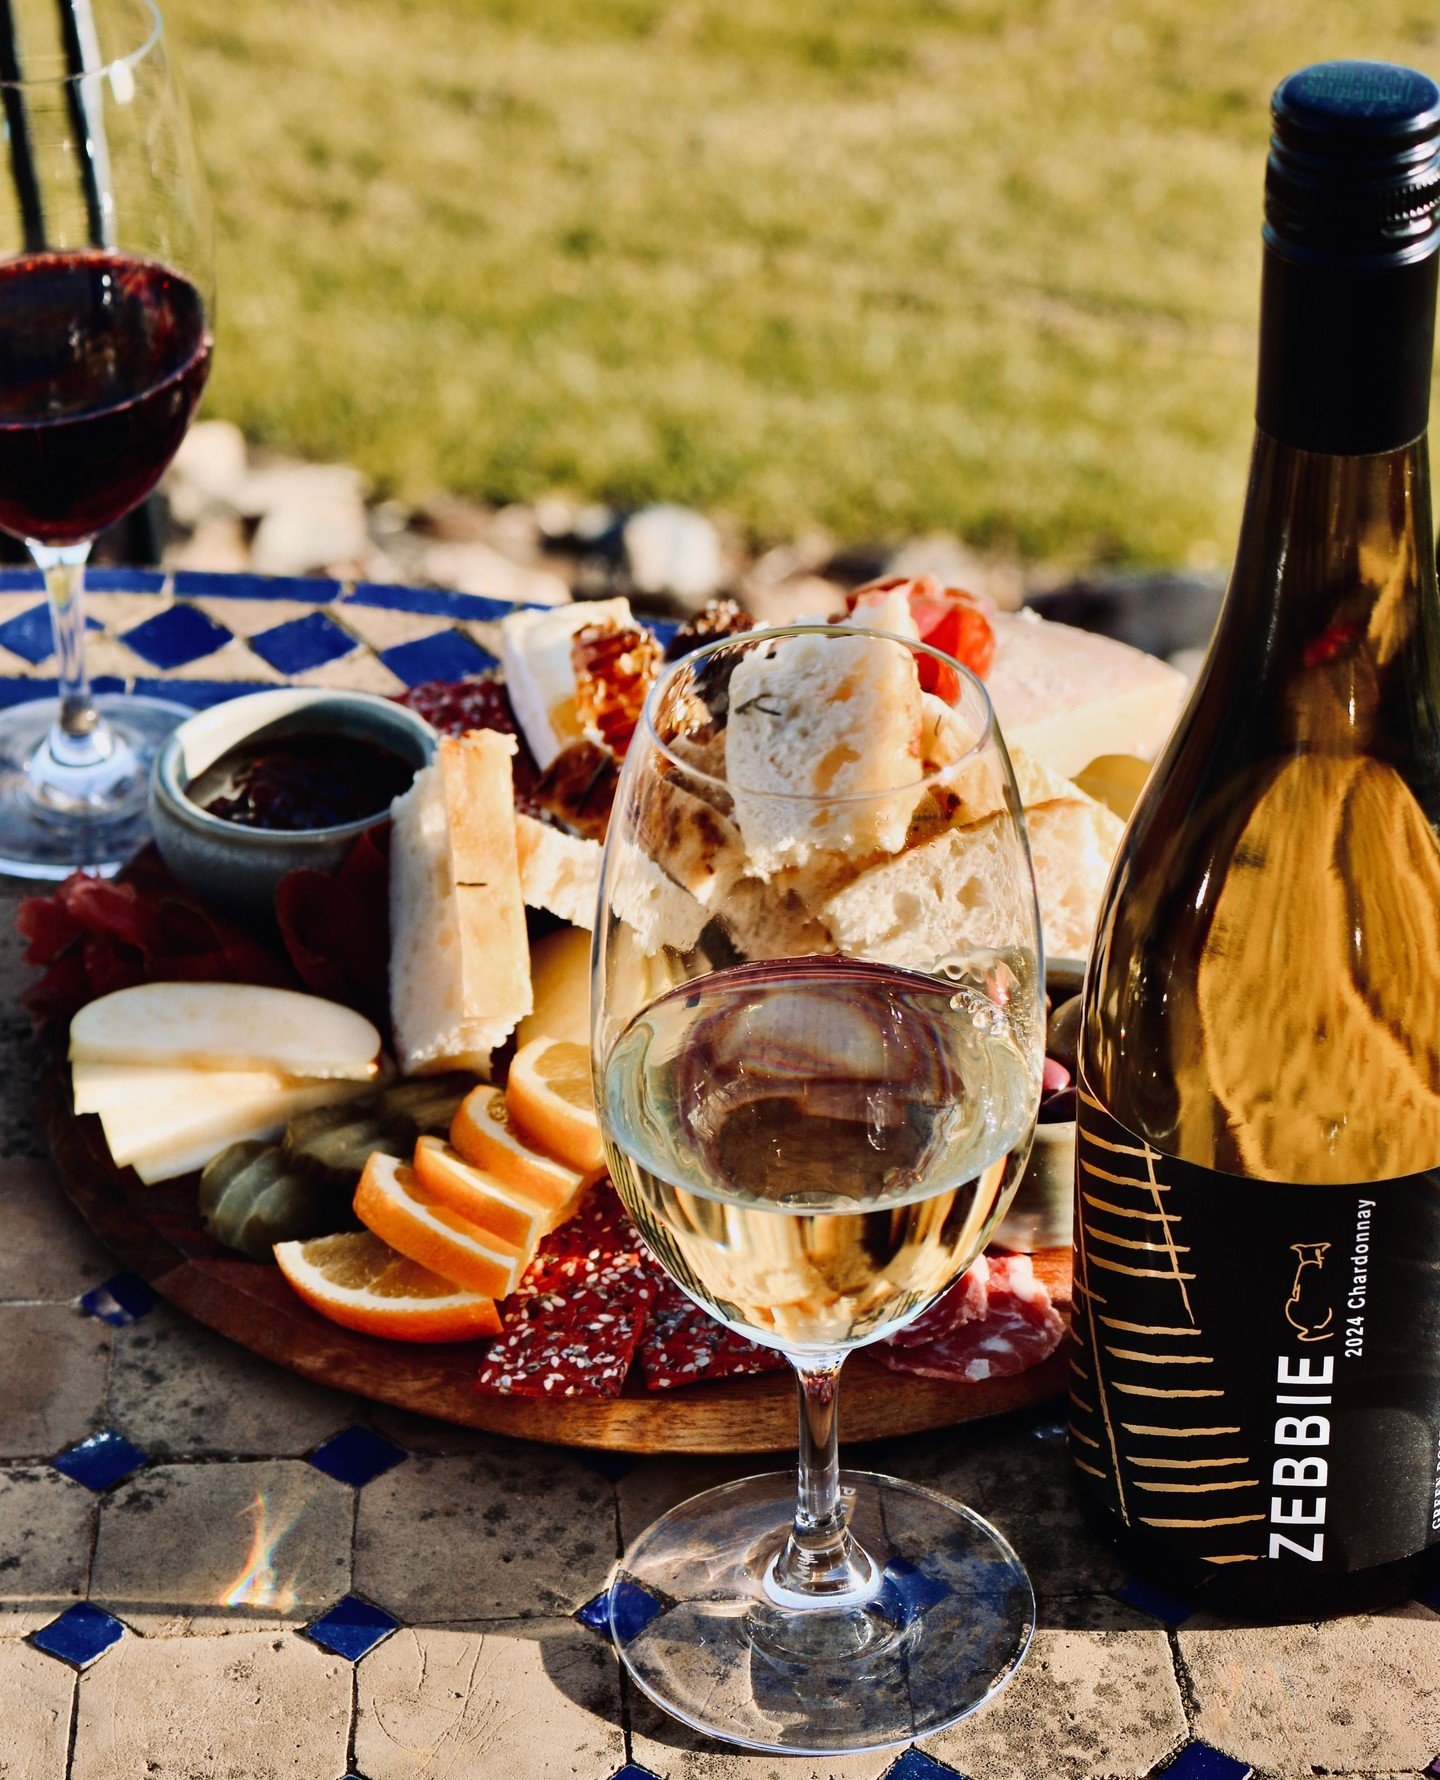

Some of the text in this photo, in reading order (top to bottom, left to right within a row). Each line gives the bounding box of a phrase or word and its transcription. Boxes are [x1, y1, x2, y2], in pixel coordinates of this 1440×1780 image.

[1344, 1199, 1377, 1358] 2024 Chardonnay
[1268, 1355, 1335, 1562] ZEBBIE
